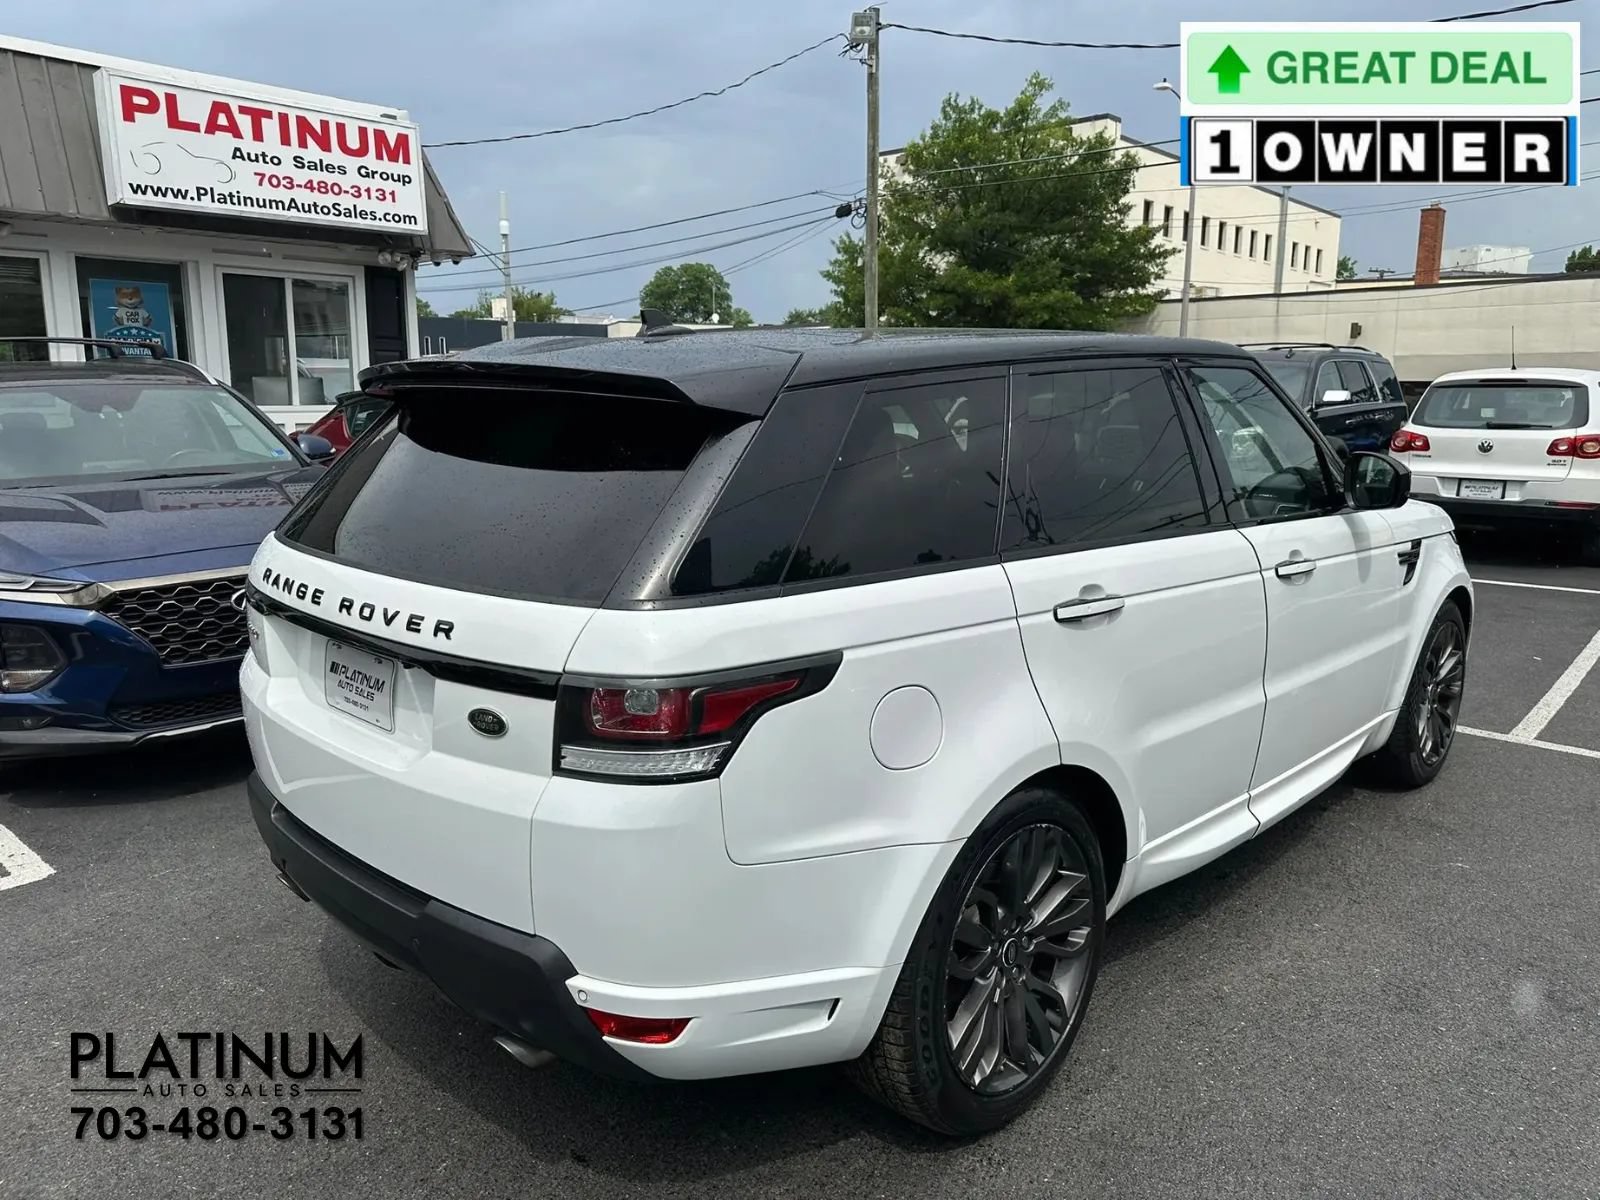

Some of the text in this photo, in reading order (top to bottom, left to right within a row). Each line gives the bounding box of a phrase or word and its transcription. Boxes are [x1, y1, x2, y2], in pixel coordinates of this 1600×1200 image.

[119, 84, 411, 165] PLATINUM
[231, 146, 412, 186] Auto Sales Group
[128, 182, 417, 226] www.PlatinumAutoSales.com
[253, 172, 397, 203] 703-480-3131
[121, 346, 152, 356] VANTA
[262, 567, 455, 640] RANGE ROVER
[336, 678, 375, 702] AUTO SALES
[338, 664, 386, 693] PLATINUM
